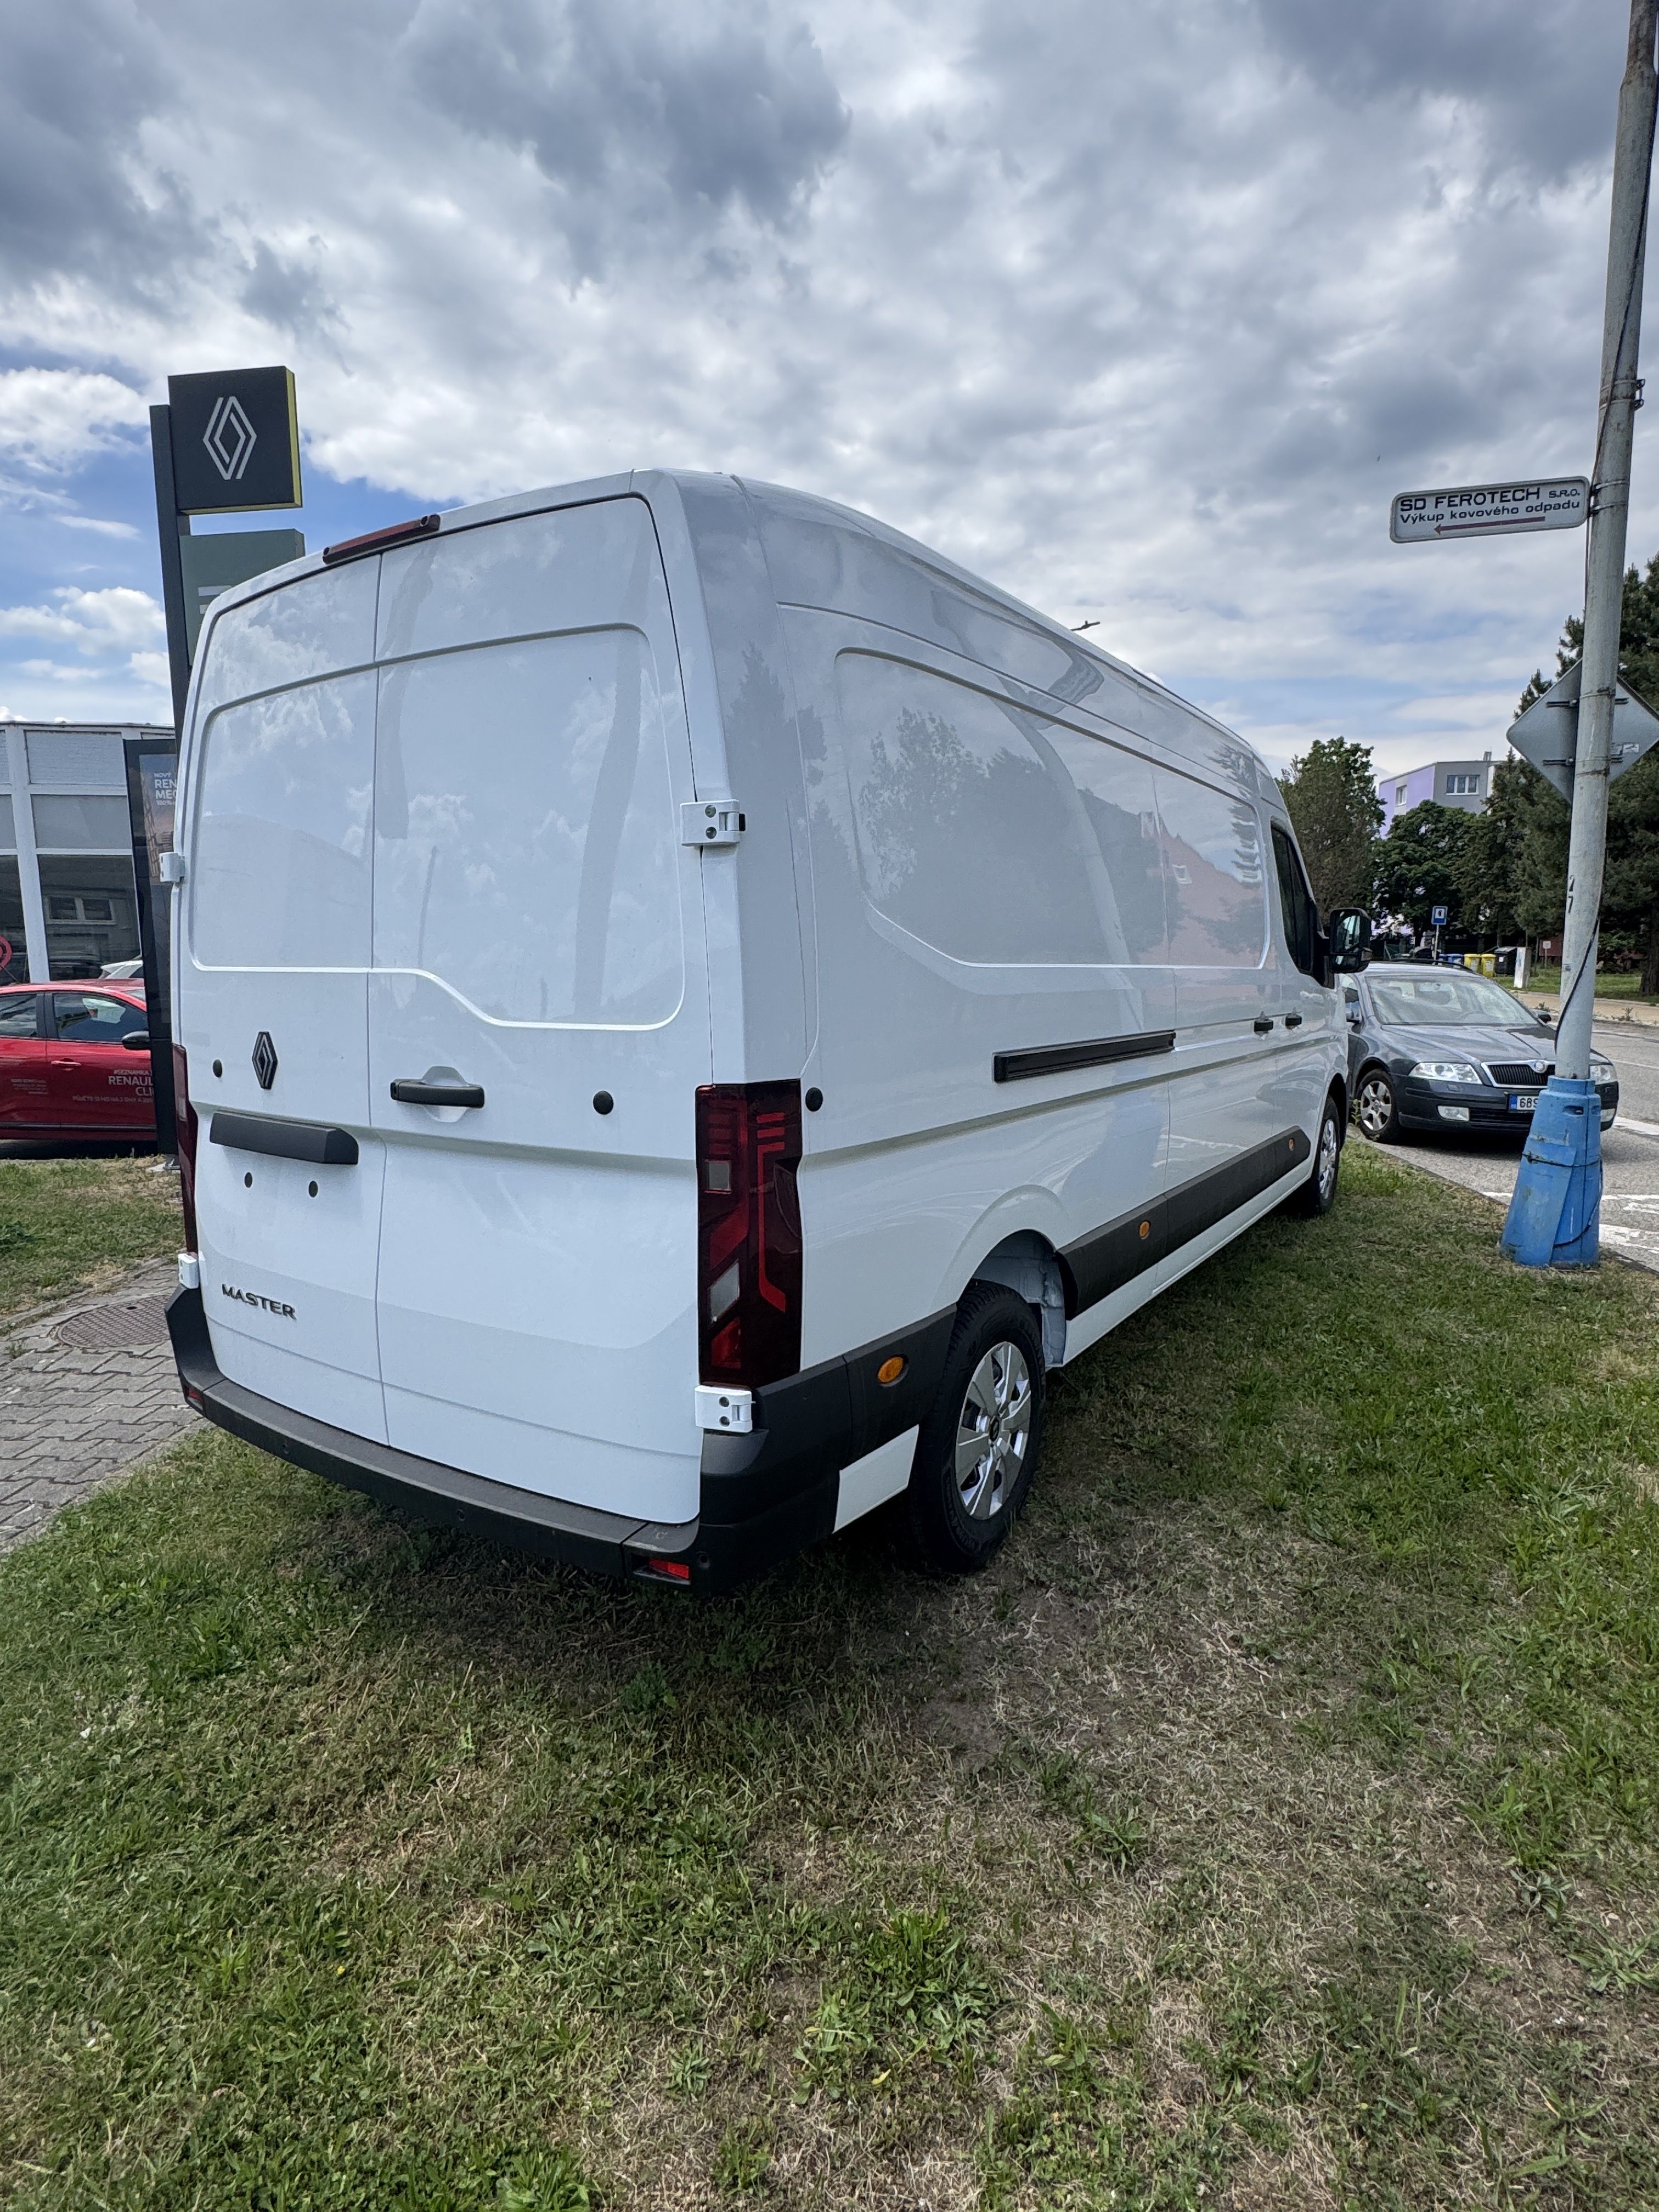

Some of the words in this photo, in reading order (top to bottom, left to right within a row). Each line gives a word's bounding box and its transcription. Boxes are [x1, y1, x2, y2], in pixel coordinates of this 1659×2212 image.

[1400, 498, 1426, 511] SD
[1435, 487, 1540, 509] FEROTECH
[1400, 512, 1444, 524] Výkup
[1450, 505, 1519, 520] kovového
[1525, 499, 1580, 513] odpadu
[155, 779, 177, 789] REN
[108, 1075, 154, 1086] RENAUL
[222, 1284, 297, 1321] MASTER
